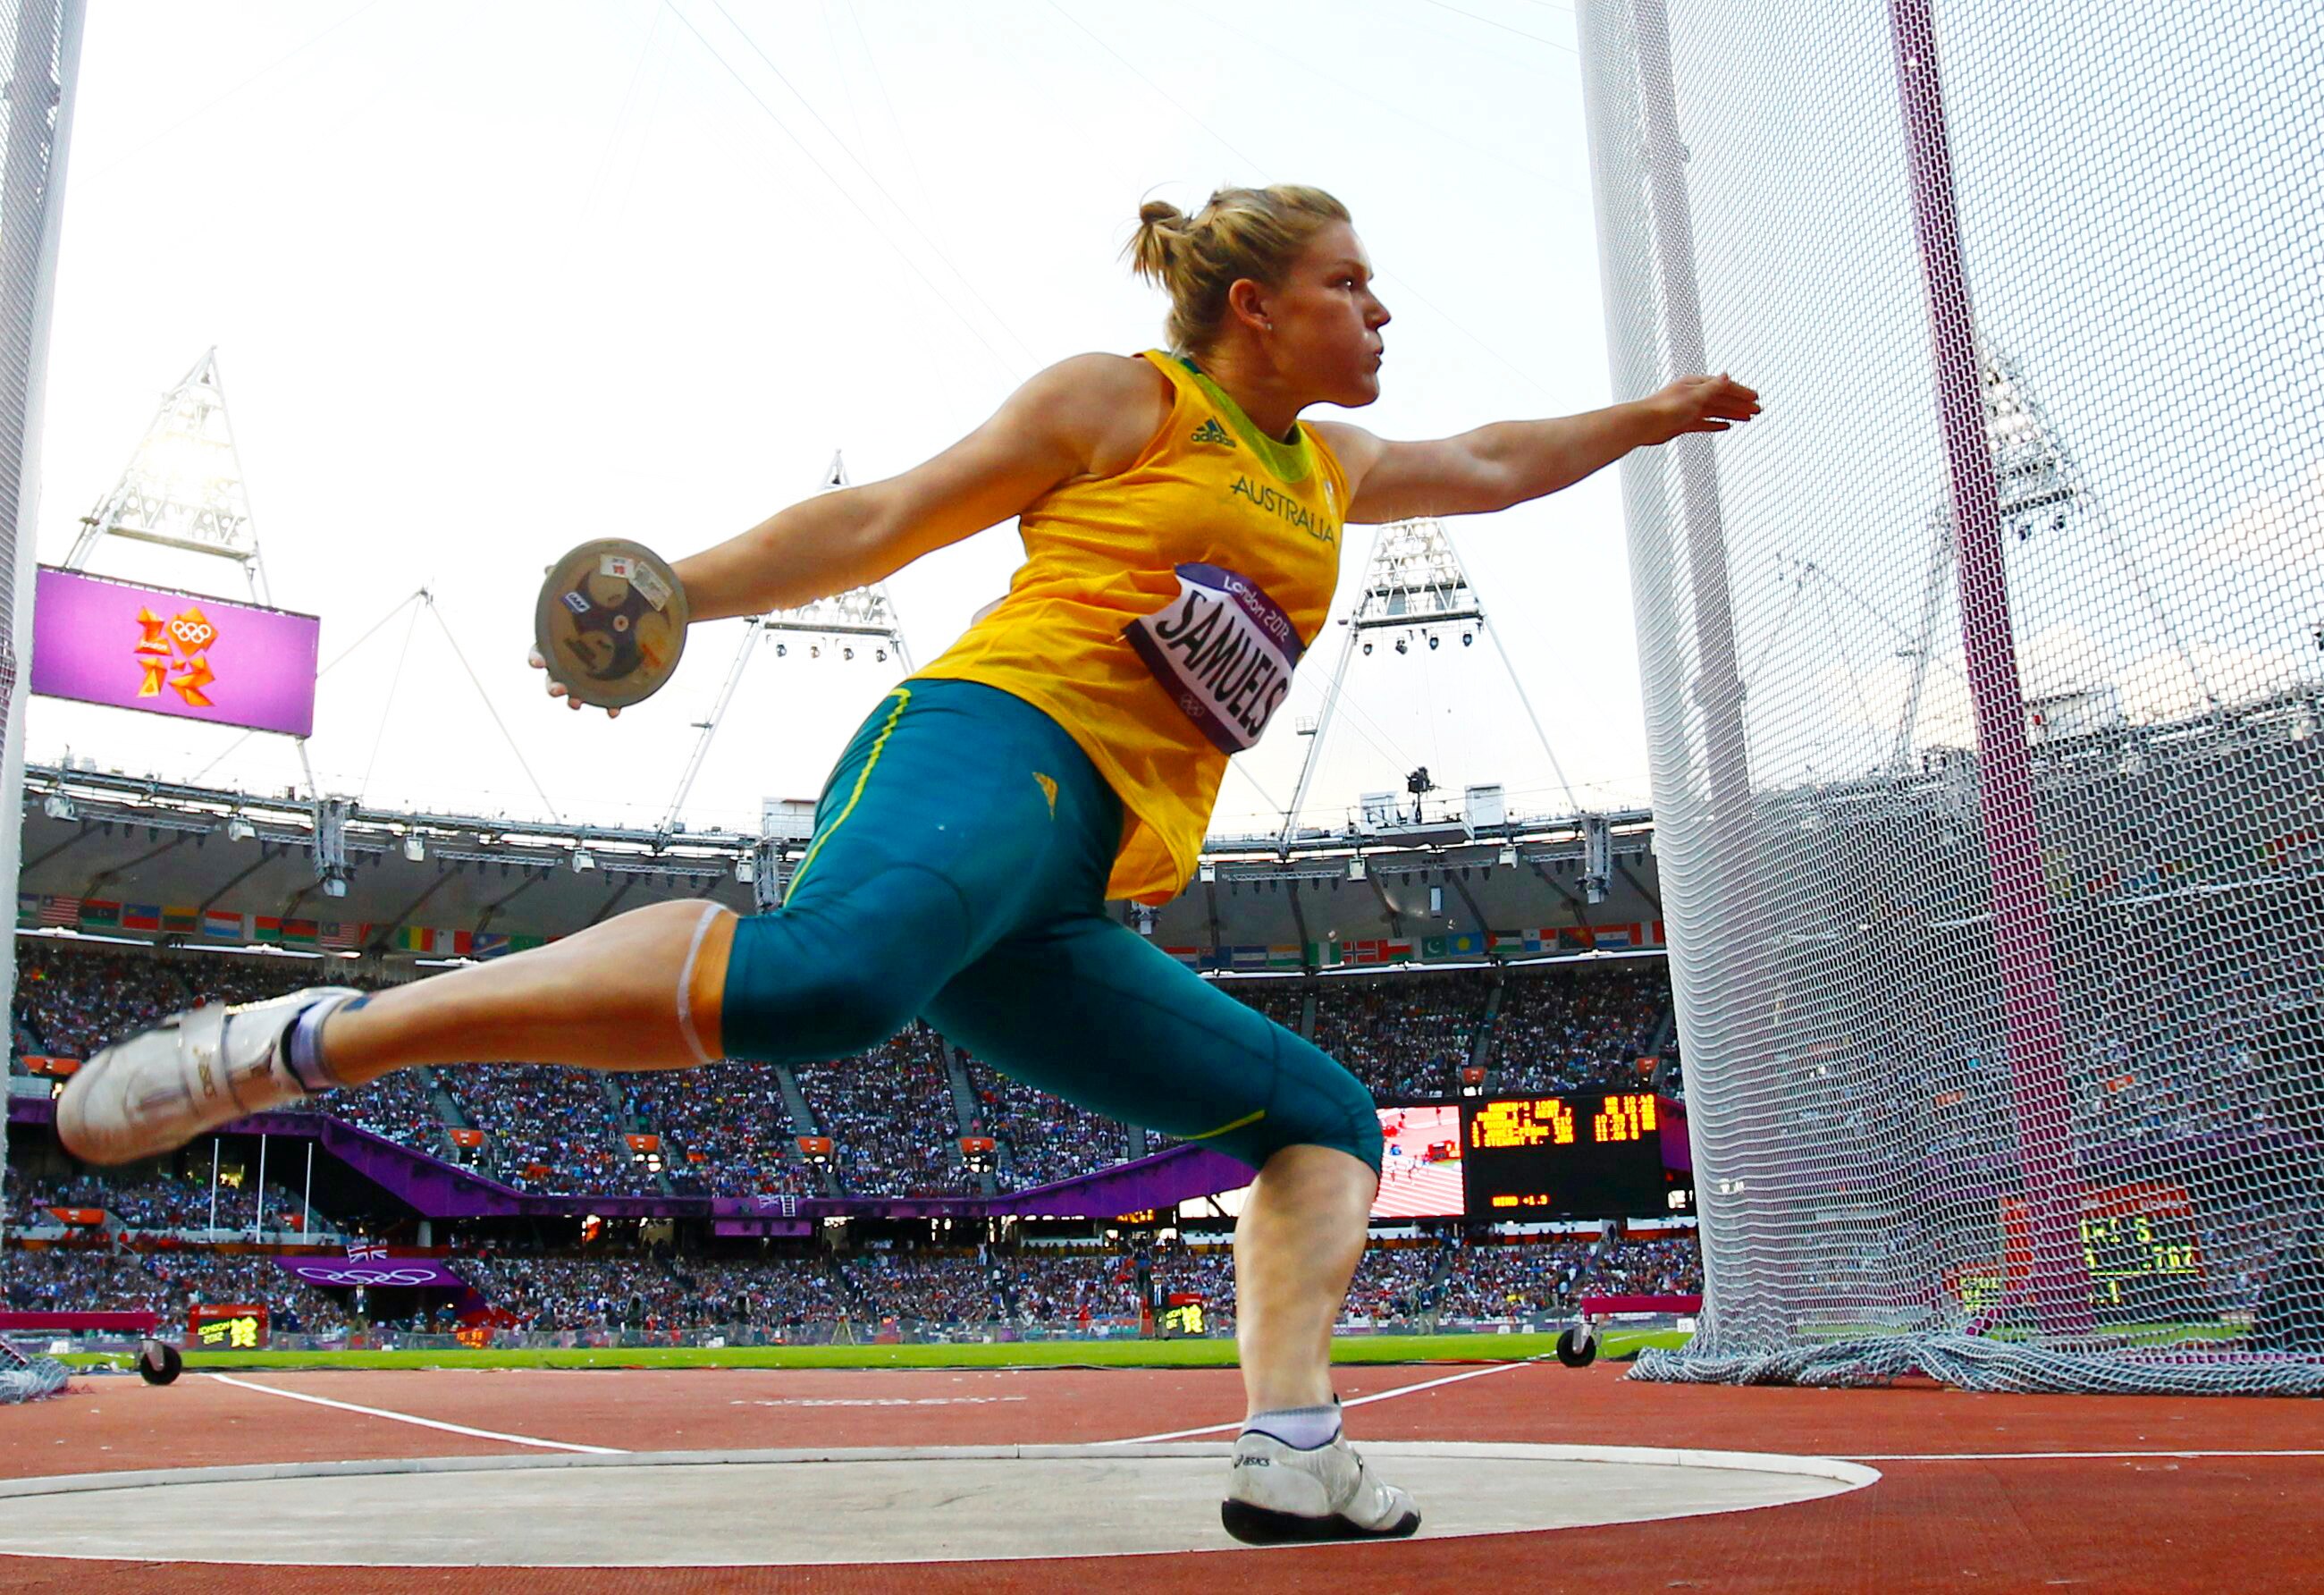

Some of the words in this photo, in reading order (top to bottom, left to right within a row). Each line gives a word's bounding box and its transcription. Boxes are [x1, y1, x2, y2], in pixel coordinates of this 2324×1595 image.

[1191, 431, 1236, 448] adidas
[1230, 475, 1335, 550] AUSTRALIA
[1224, 575, 1266, 619] London
[1264, 610, 1291, 643] 2012
[1156, 589, 1288, 738] SAMUELS
[1564, 1107, 1571, 1117] 7
[198, 1321, 230, 1336] LONDON
[203, 1331, 224, 1345] 2012
